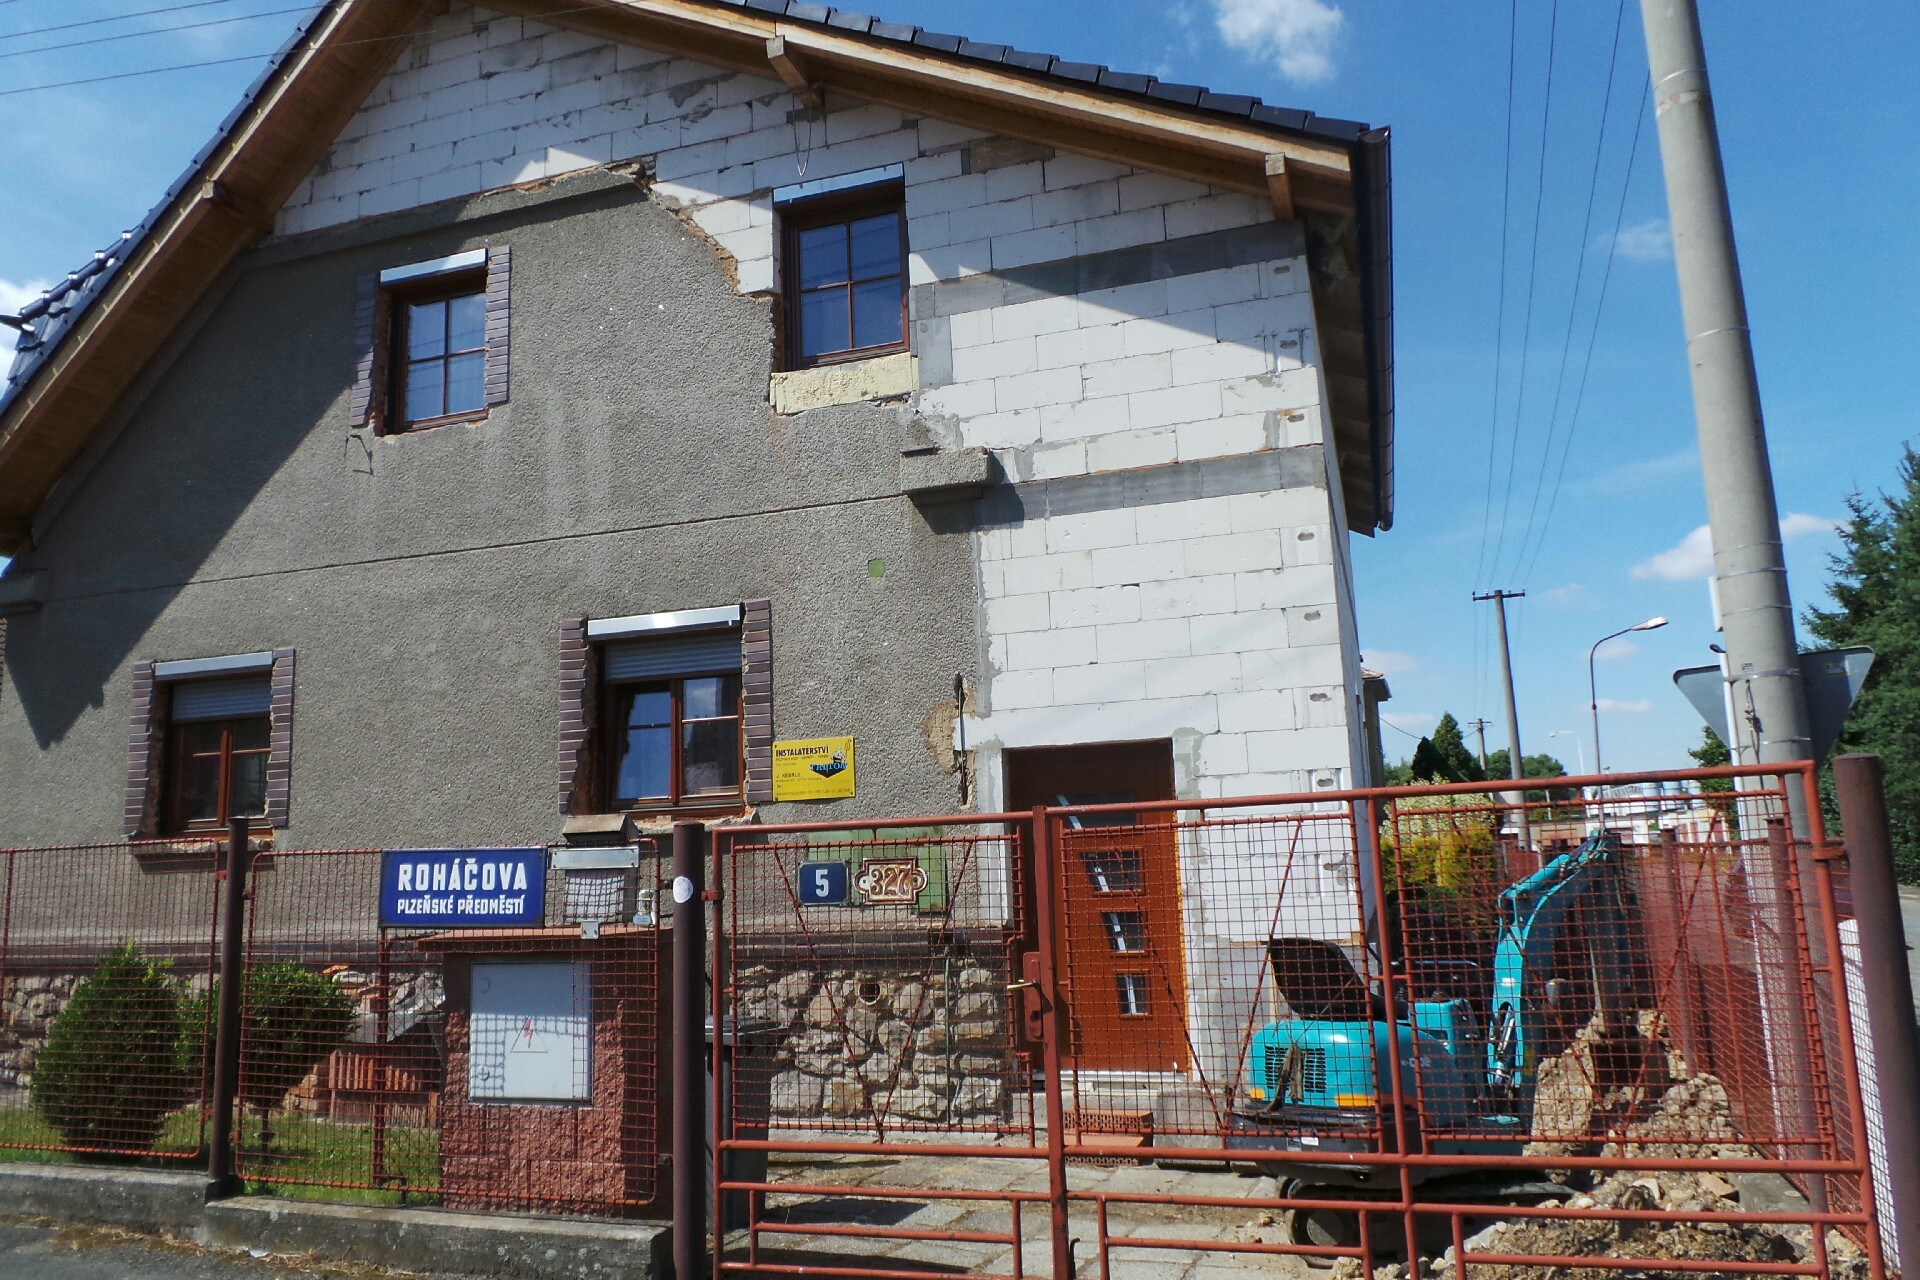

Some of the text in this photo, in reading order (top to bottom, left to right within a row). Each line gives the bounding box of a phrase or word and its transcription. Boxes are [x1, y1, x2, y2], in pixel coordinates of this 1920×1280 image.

[775, 743, 829, 757] INSTALATÉRSTVÍ
[397, 857, 528, 891] ROHÁČOVA
[815, 869, 829, 897] 5
[870, 866, 910, 896] 327
[397, 894, 526, 915] PLZEŇSKÉ PŘEDMĚSTÍ
